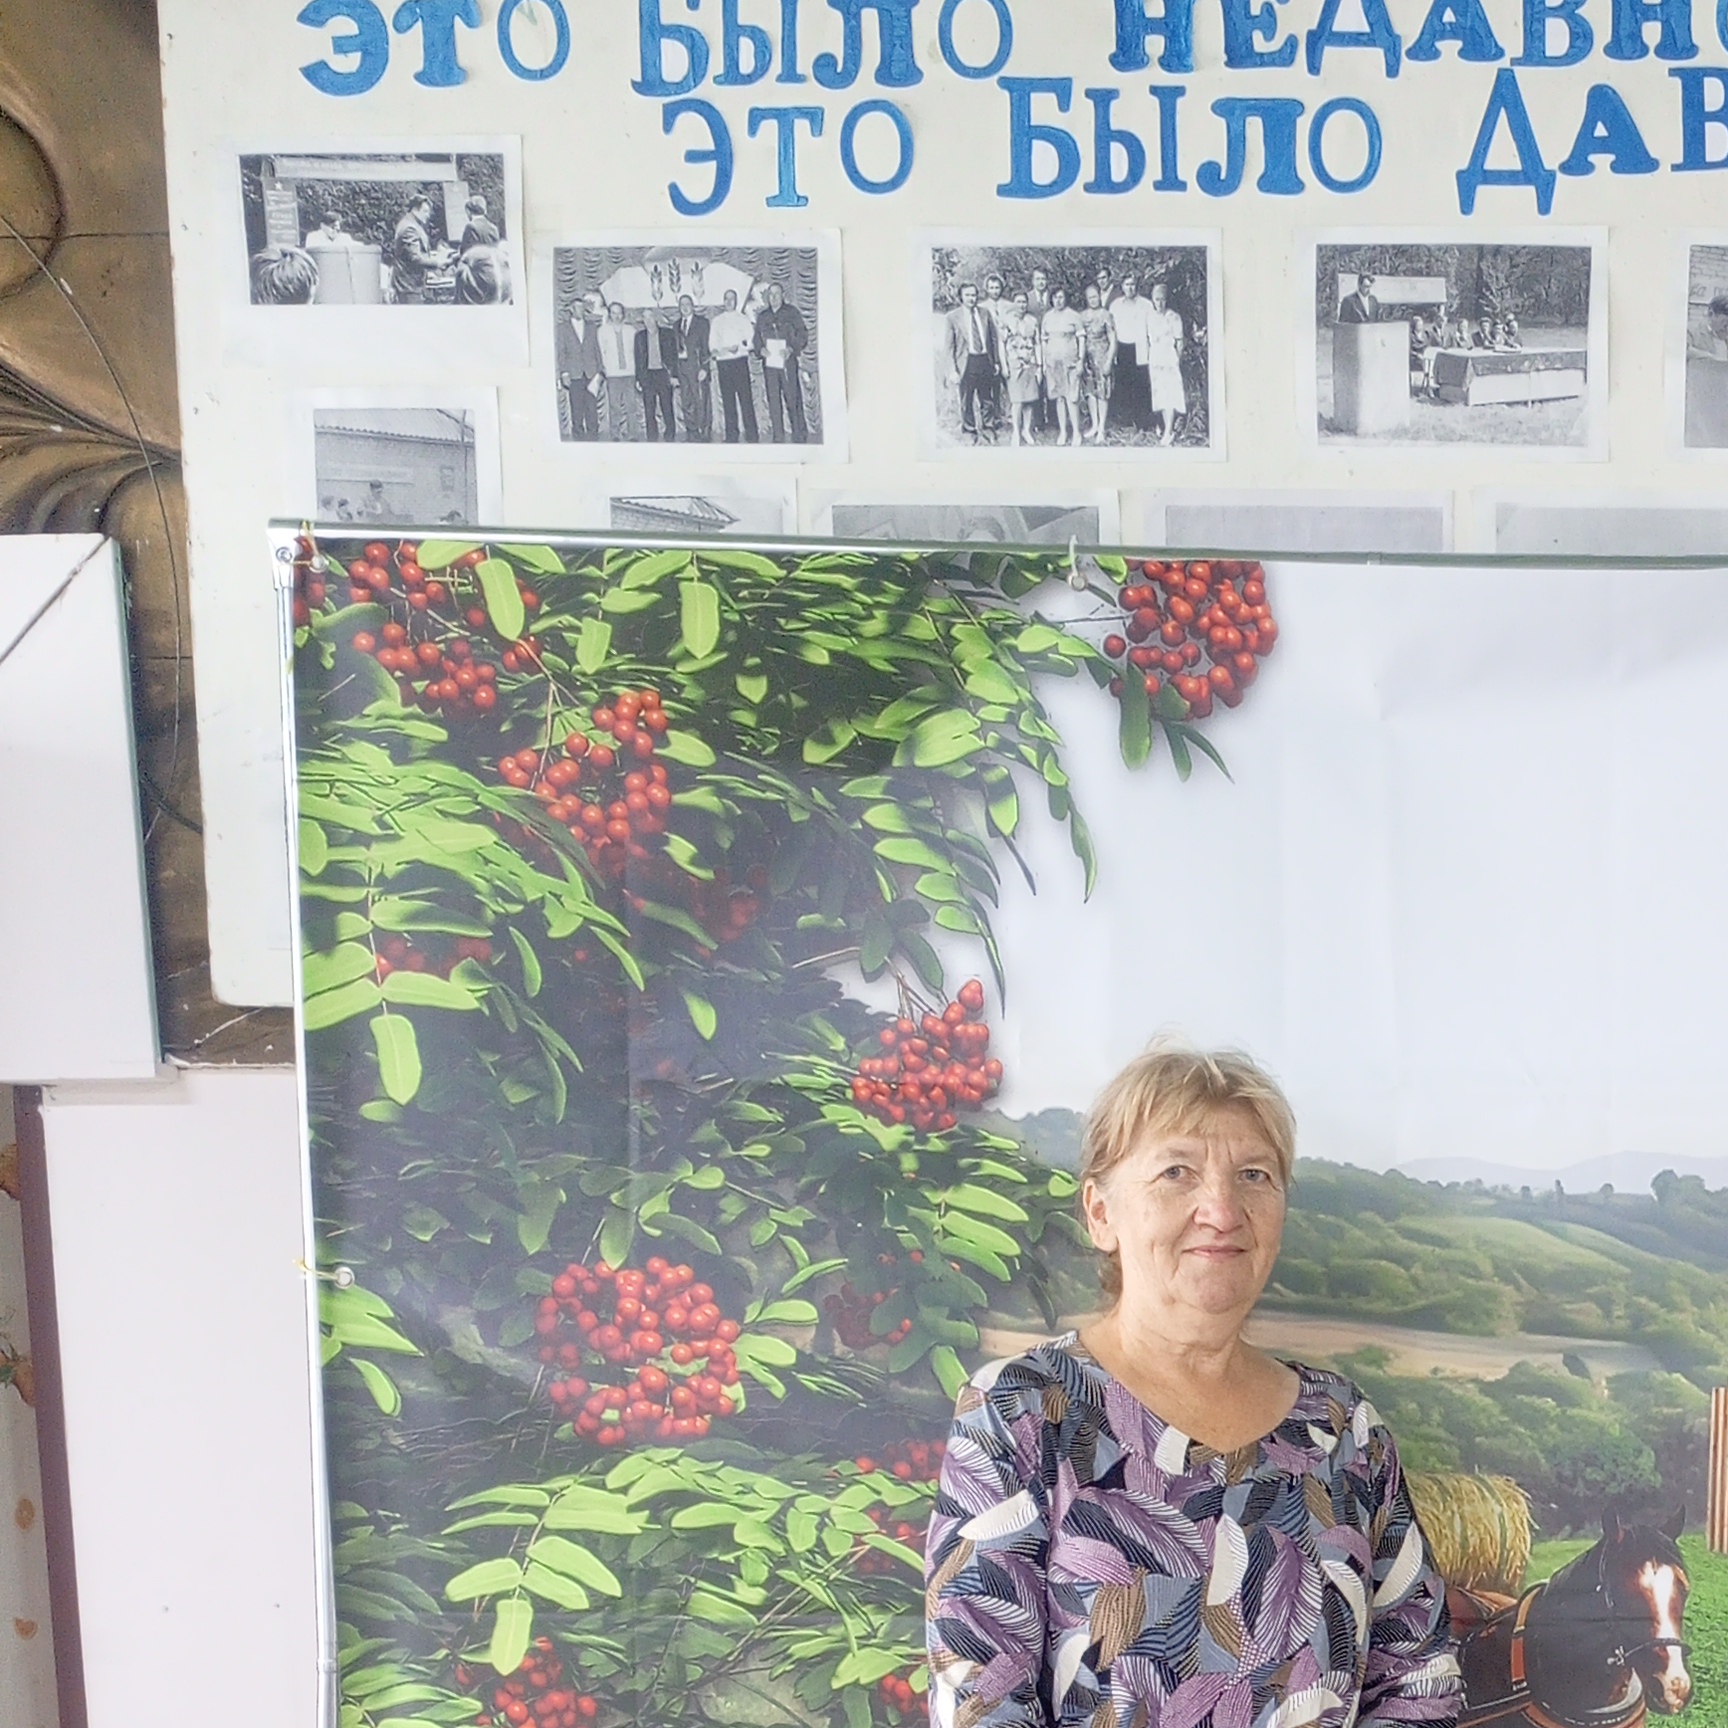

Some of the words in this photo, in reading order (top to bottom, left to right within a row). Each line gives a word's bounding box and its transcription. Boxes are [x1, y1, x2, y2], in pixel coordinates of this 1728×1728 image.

[298, 0, 571, 97] ЭТО
[631, 0, 1014, 98] БЫЛО
[662, 97, 915, 217] ЭТО
[996, 75, 1384, 199] БЫЛО
